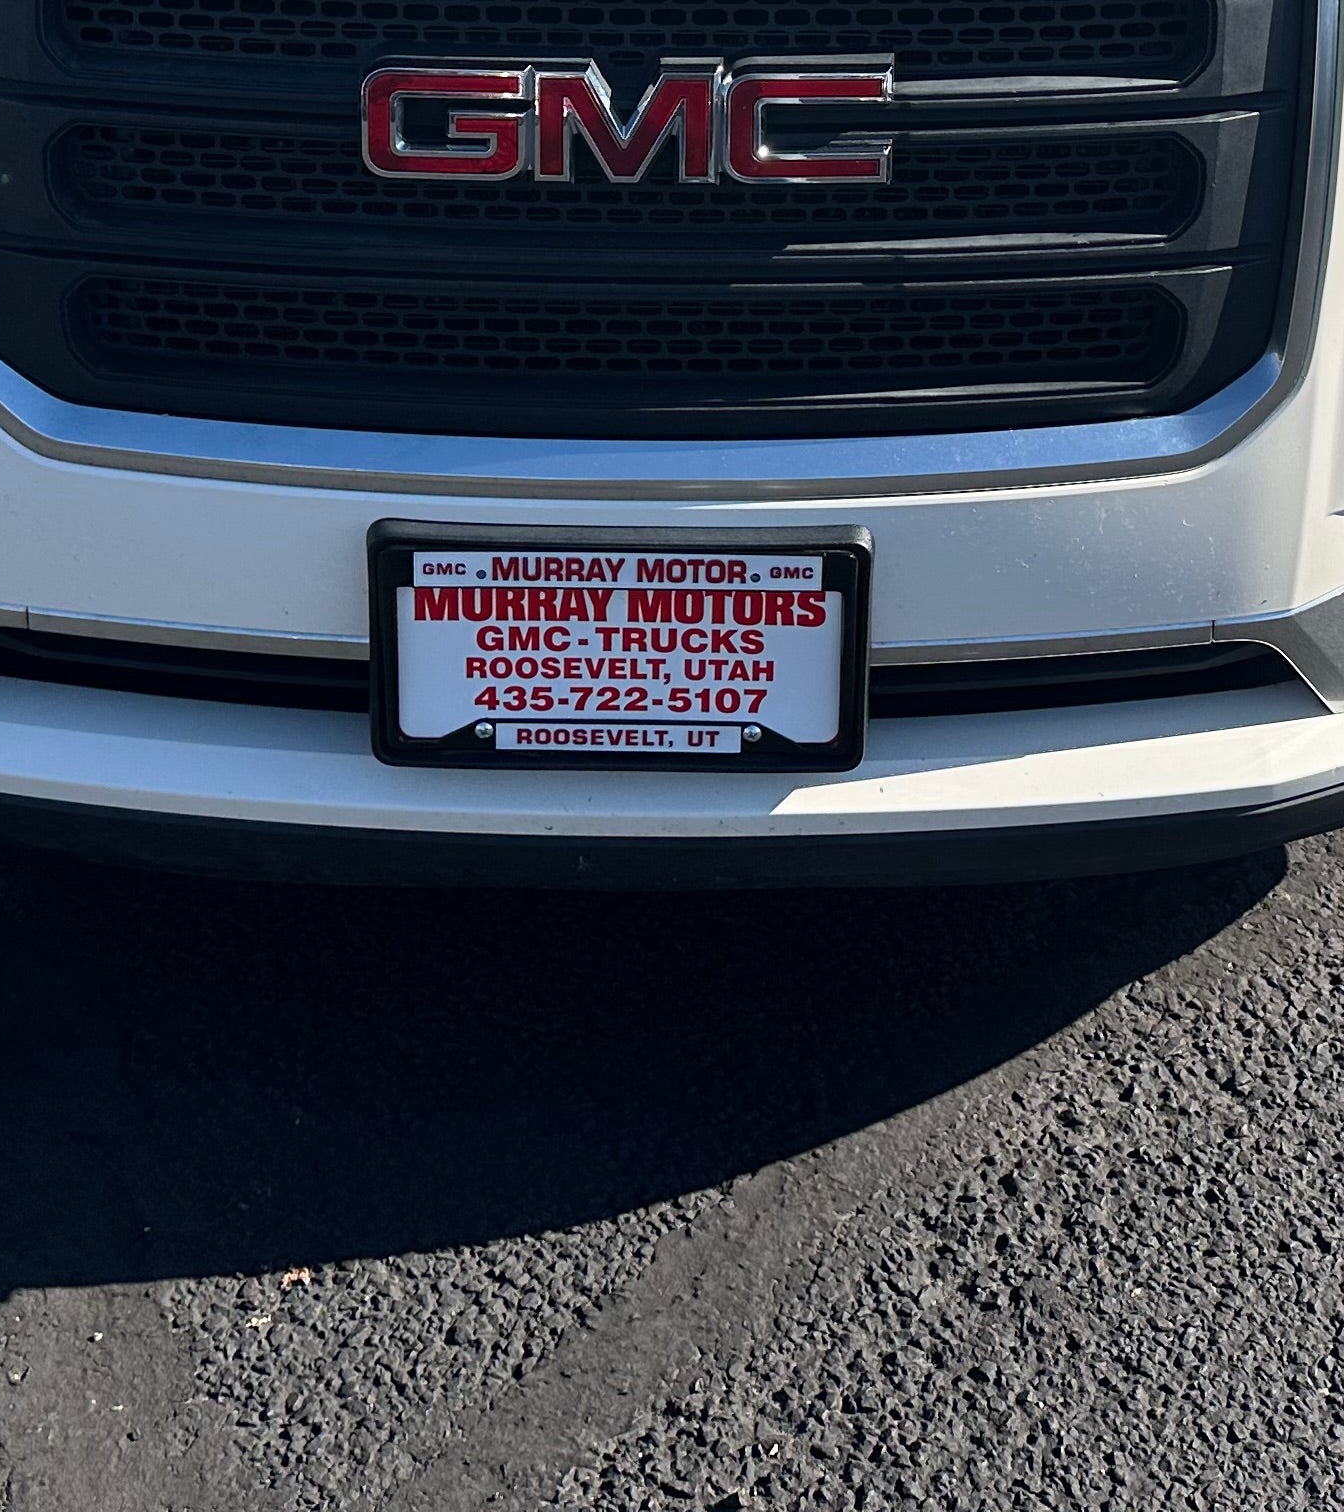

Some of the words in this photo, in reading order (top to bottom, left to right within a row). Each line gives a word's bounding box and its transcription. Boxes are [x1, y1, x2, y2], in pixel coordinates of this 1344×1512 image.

[361, 53, 895, 185] GMC
[421, 562, 467, 576] GMC
[491, 556, 626, 584] MURRAY
[636, 558, 747, 584] MOTOR
[769, 566, 814, 580] GMC
[414, 588, 611, 623] MURRAY
[627, 590, 826, 627] MOTORS
[465, 657, 672, 686] ROOSEVELT,
[684, 659, 775, 683] UTAH
[474, 685, 769, 714] 435-722-5107
[516, 728, 674, 748] ROOSEVELT,
[687, 730, 720, 747] UT
